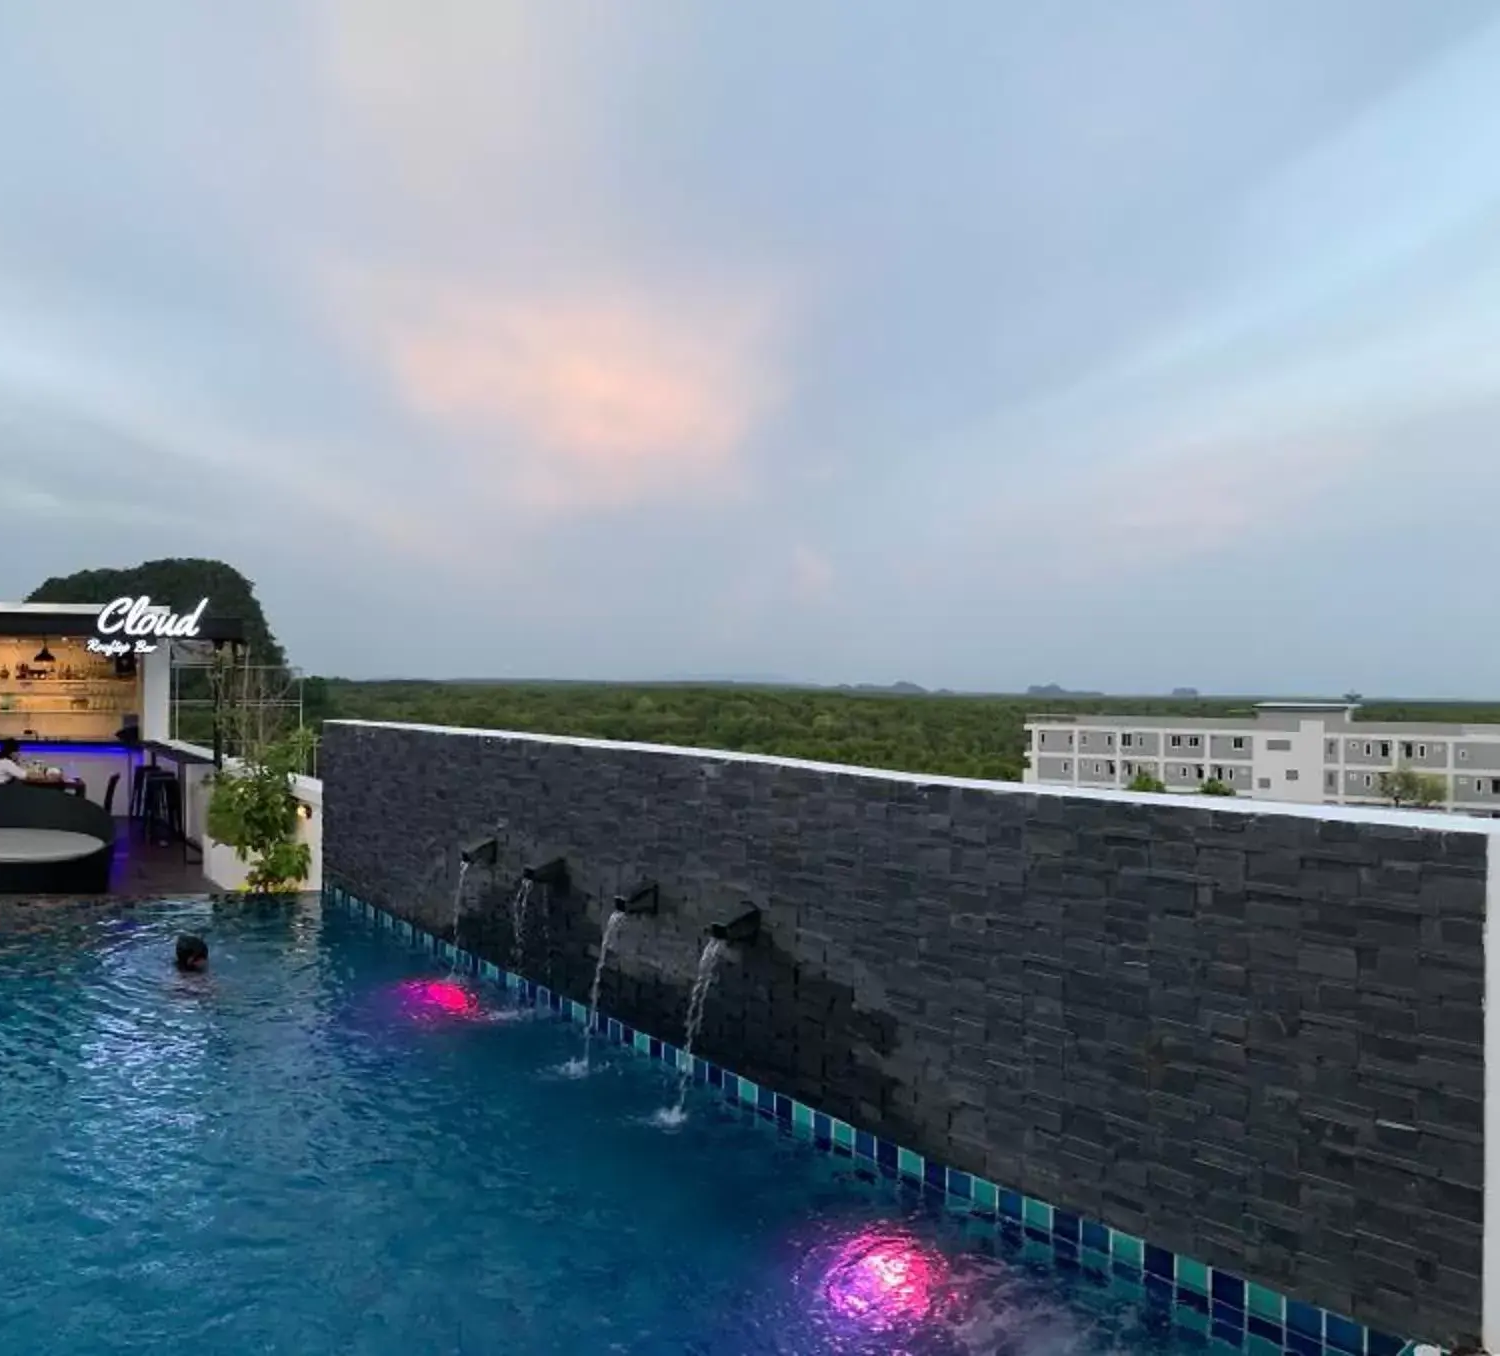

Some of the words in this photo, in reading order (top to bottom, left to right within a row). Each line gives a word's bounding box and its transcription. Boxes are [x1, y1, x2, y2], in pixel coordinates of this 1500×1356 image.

[97, 595, 209, 636] Cloud
[86, 638, 130, 656] Rooftop
[134, 639, 158, 653] Bar
